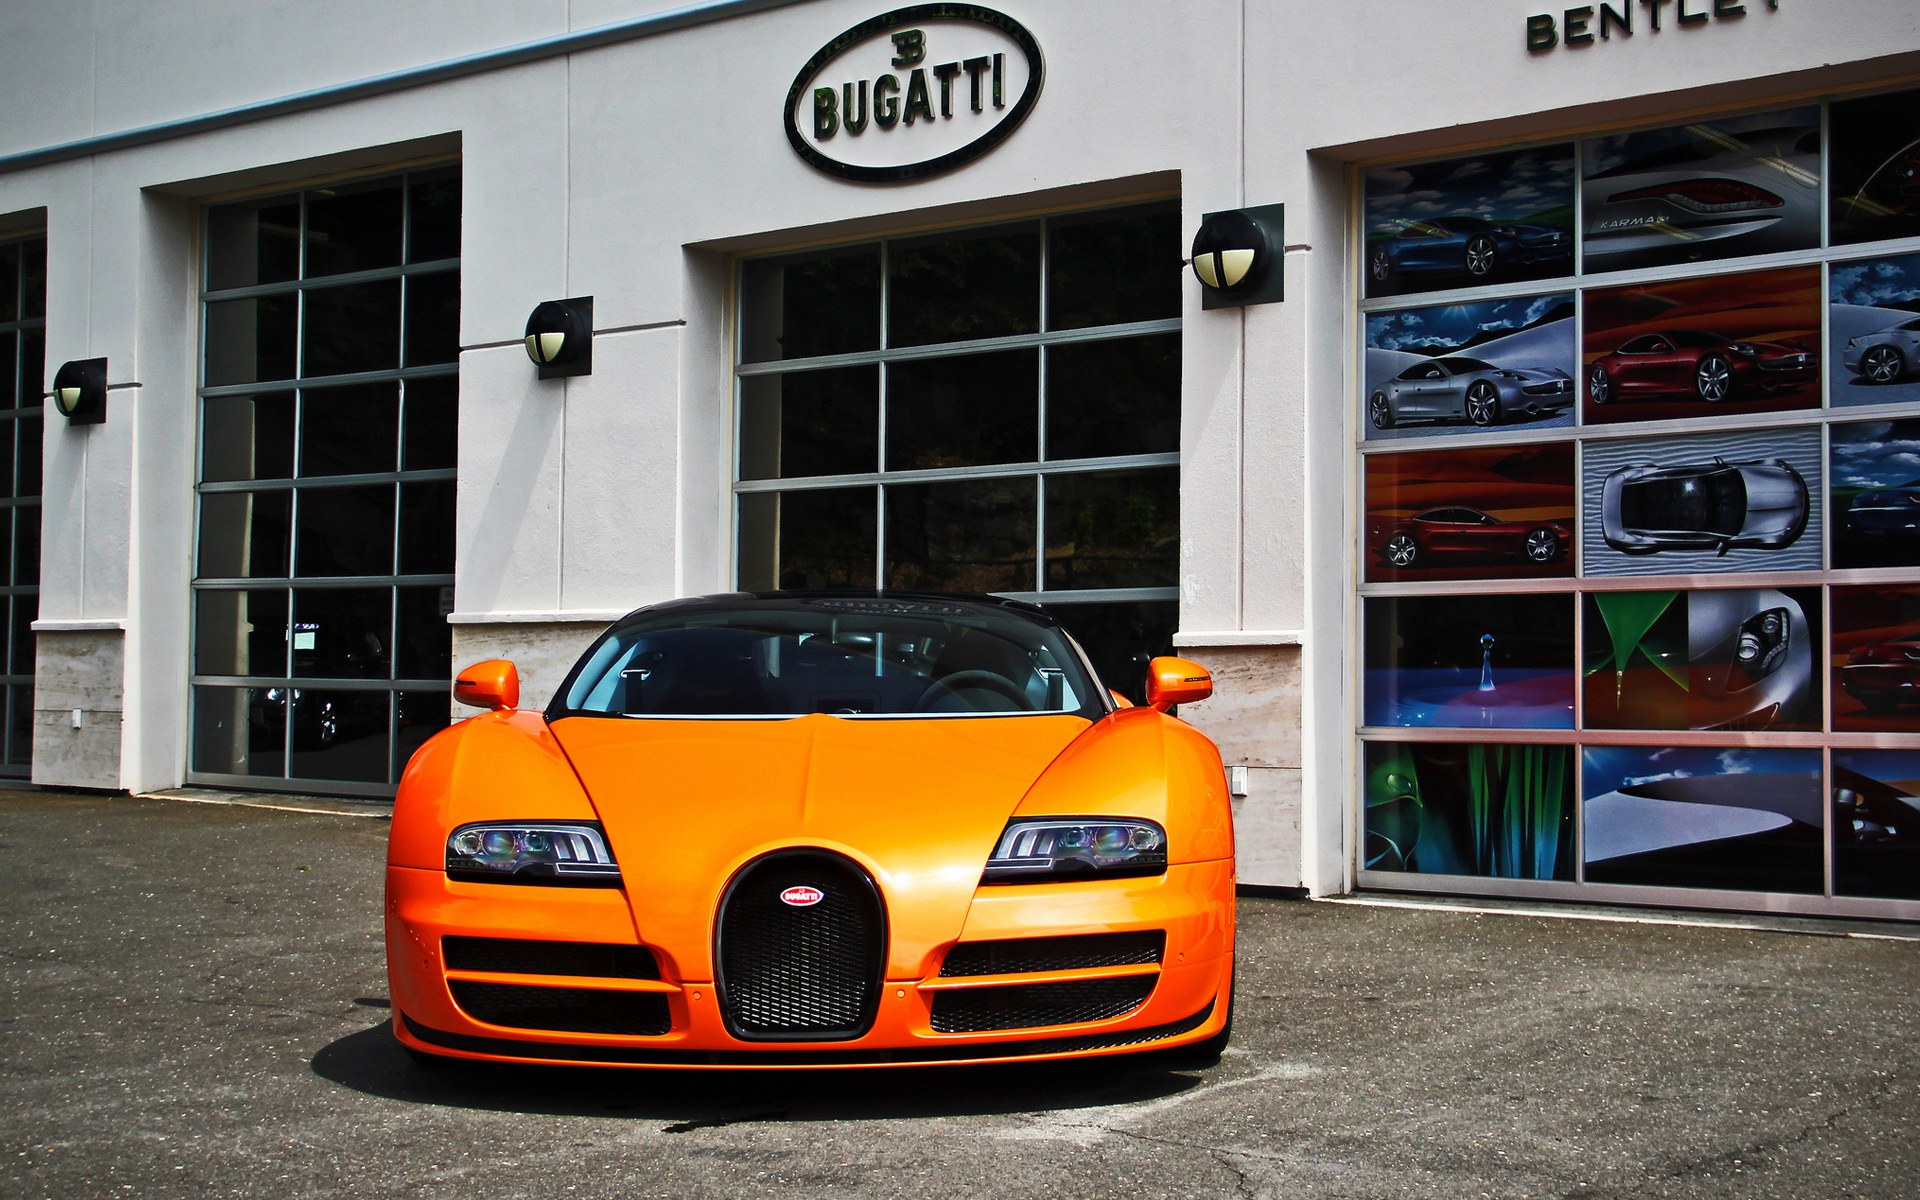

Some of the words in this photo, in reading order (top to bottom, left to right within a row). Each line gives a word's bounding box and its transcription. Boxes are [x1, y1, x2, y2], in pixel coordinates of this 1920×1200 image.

[1526, 0, 1778, 52] BENTLE
[813, 53, 1006, 139] BUGATTI
[1600, 216, 1655, 229] KARMA
[785, 892, 818, 901] BUGATTI
